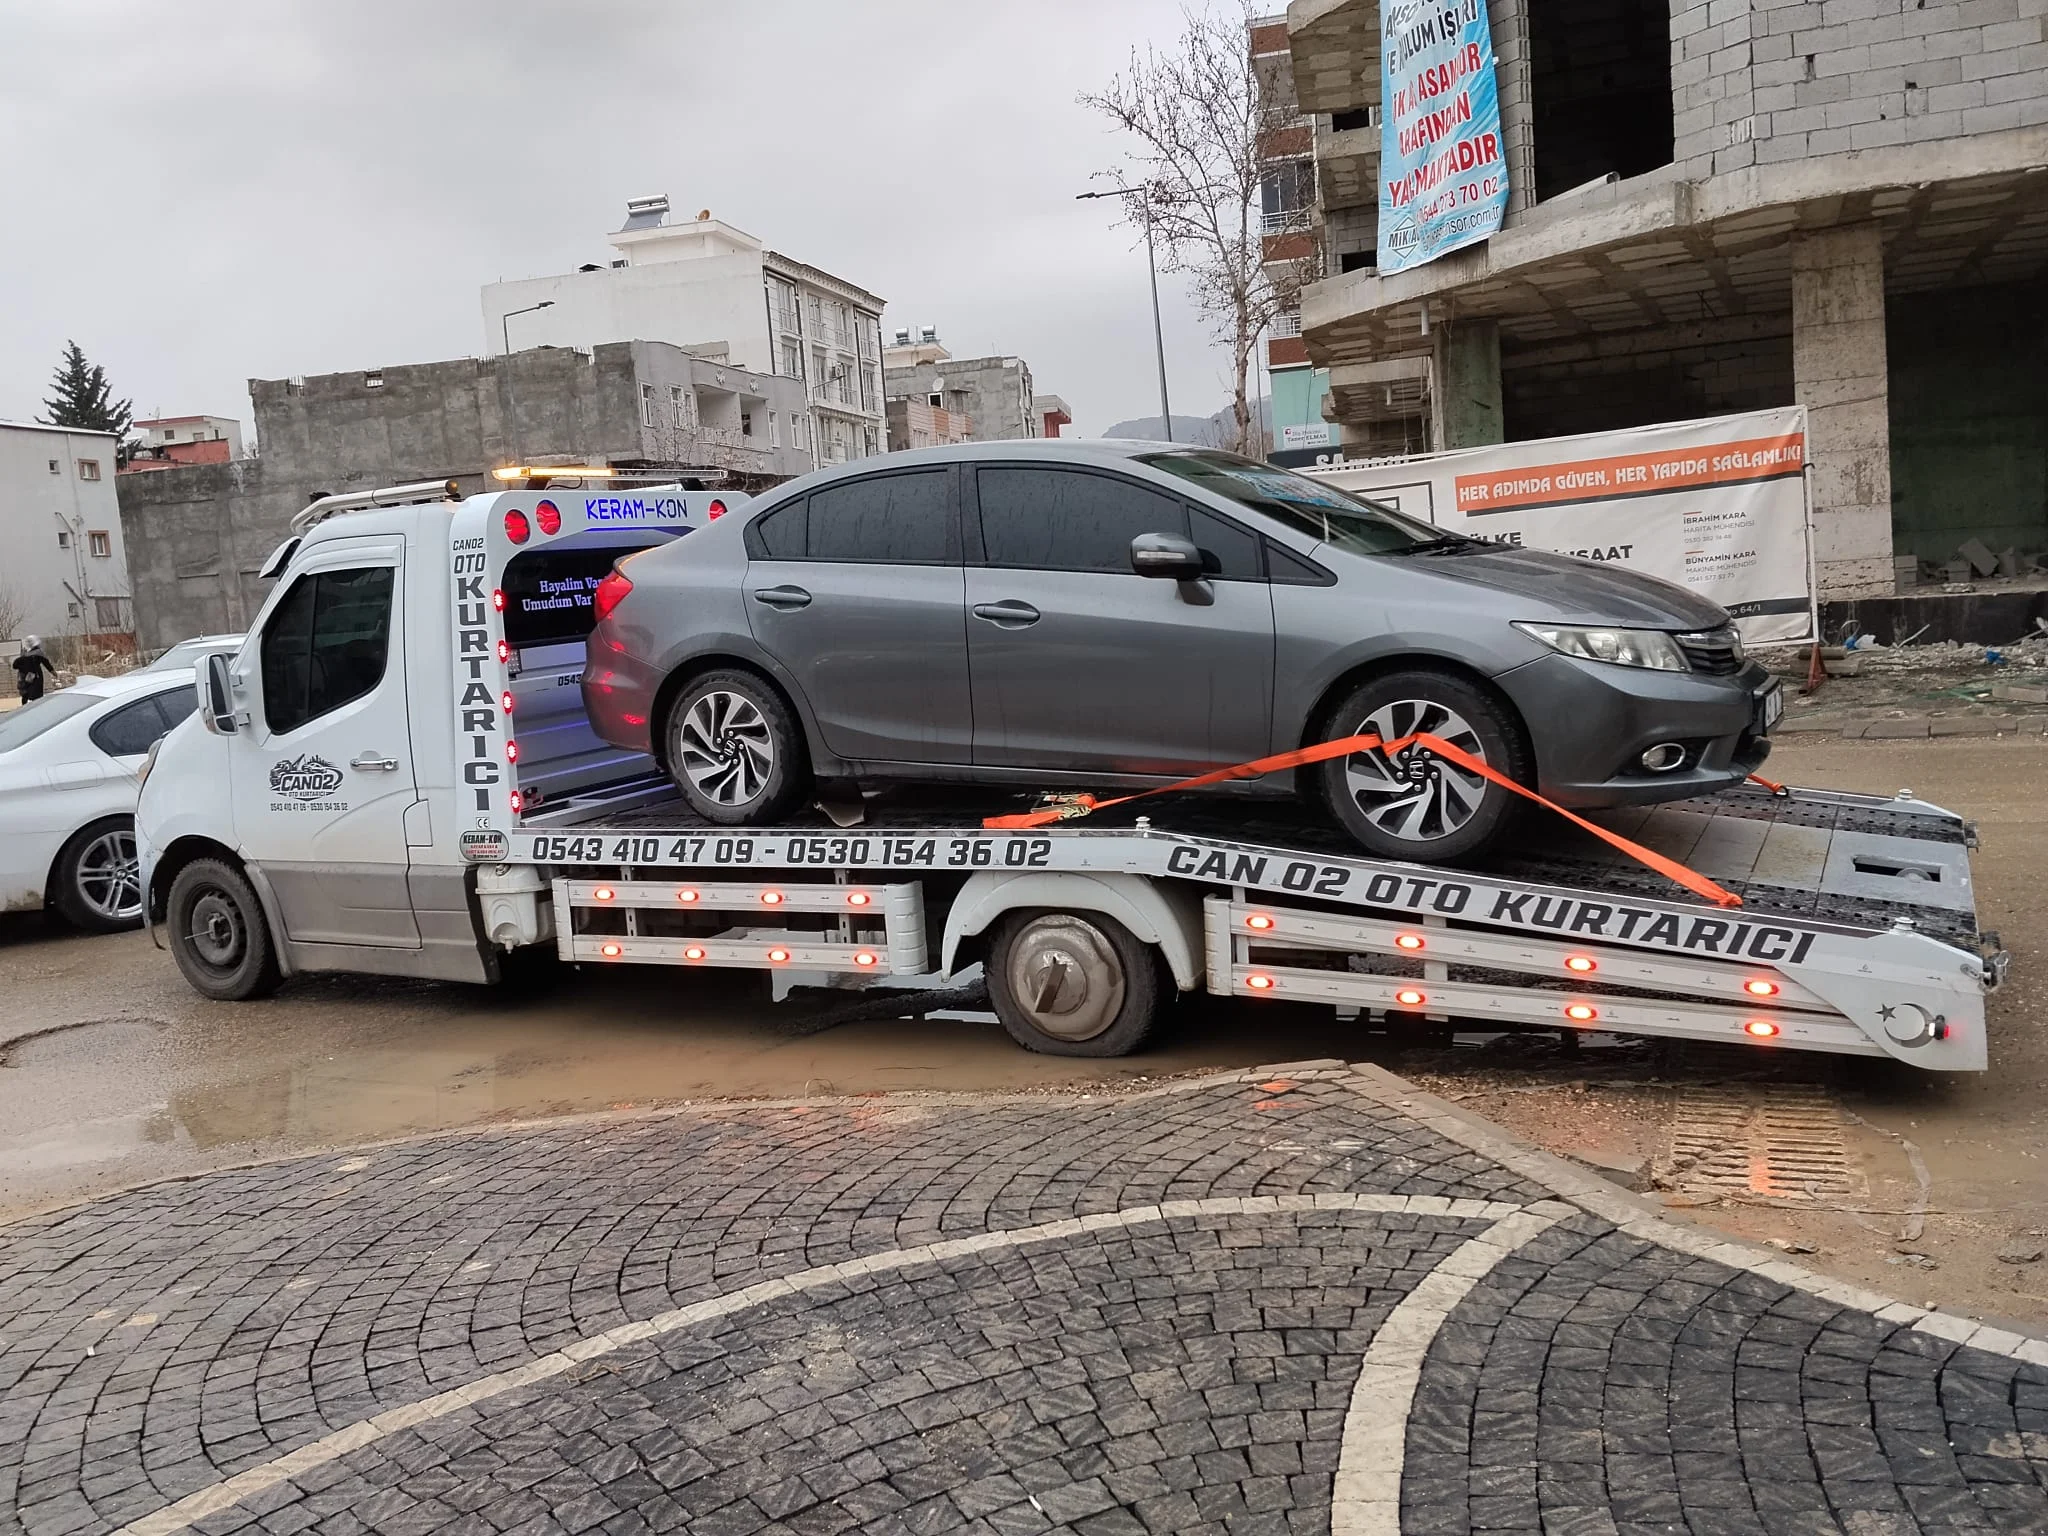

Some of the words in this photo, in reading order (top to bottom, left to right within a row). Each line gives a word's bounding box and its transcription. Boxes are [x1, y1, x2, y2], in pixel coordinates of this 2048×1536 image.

[1460, 183, 1479, 204] 70
[1483, 176, 1498, 197] 02
[1460, 486, 1488, 503] HER
[1493, 480, 1550, 498] ADIMDA
[1556, 470, 1610, 489] GÜVEN,
[1616, 468, 1646, 485] HER
[1651, 457, 1708, 480] YAPIDA
[586, 499, 688, 520] KERAM-KON
[1683, 514, 1720, 525] İBRAHİM
[1722, 511, 1746, 520] KARA
[1470, 531, 1521, 547] LKE
[454, 553, 486, 574] OTO
[1685, 552, 1731, 565] BÜNYAMİN
[1733, 550, 1756, 560] KARA
[540, 578, 583, 596] Hayalim
[522, 596, 572, 611] Umudum
[574, 595, 591, 606] Var
[1740, 604, 1760, 613] 64/1
[457, 576, 500, 811] KURTARICI
[533, 836, 602, 861] 0543
[613, 838, 658, 862] 410
[669, 838, 705, 863] 47
[715, 839, 754, 863] 09
[787, 839, 869, 865] 0530
[882, 839, 935, 865] 154
[948, 839, 994, 866] 36
[1005, 840, 1051, 866] 02
[1167, 845, 1268, 885] CAN
[1366, 874, 1472, 914] OTO
[1490, 890, 1816, 965] KURTARICI
